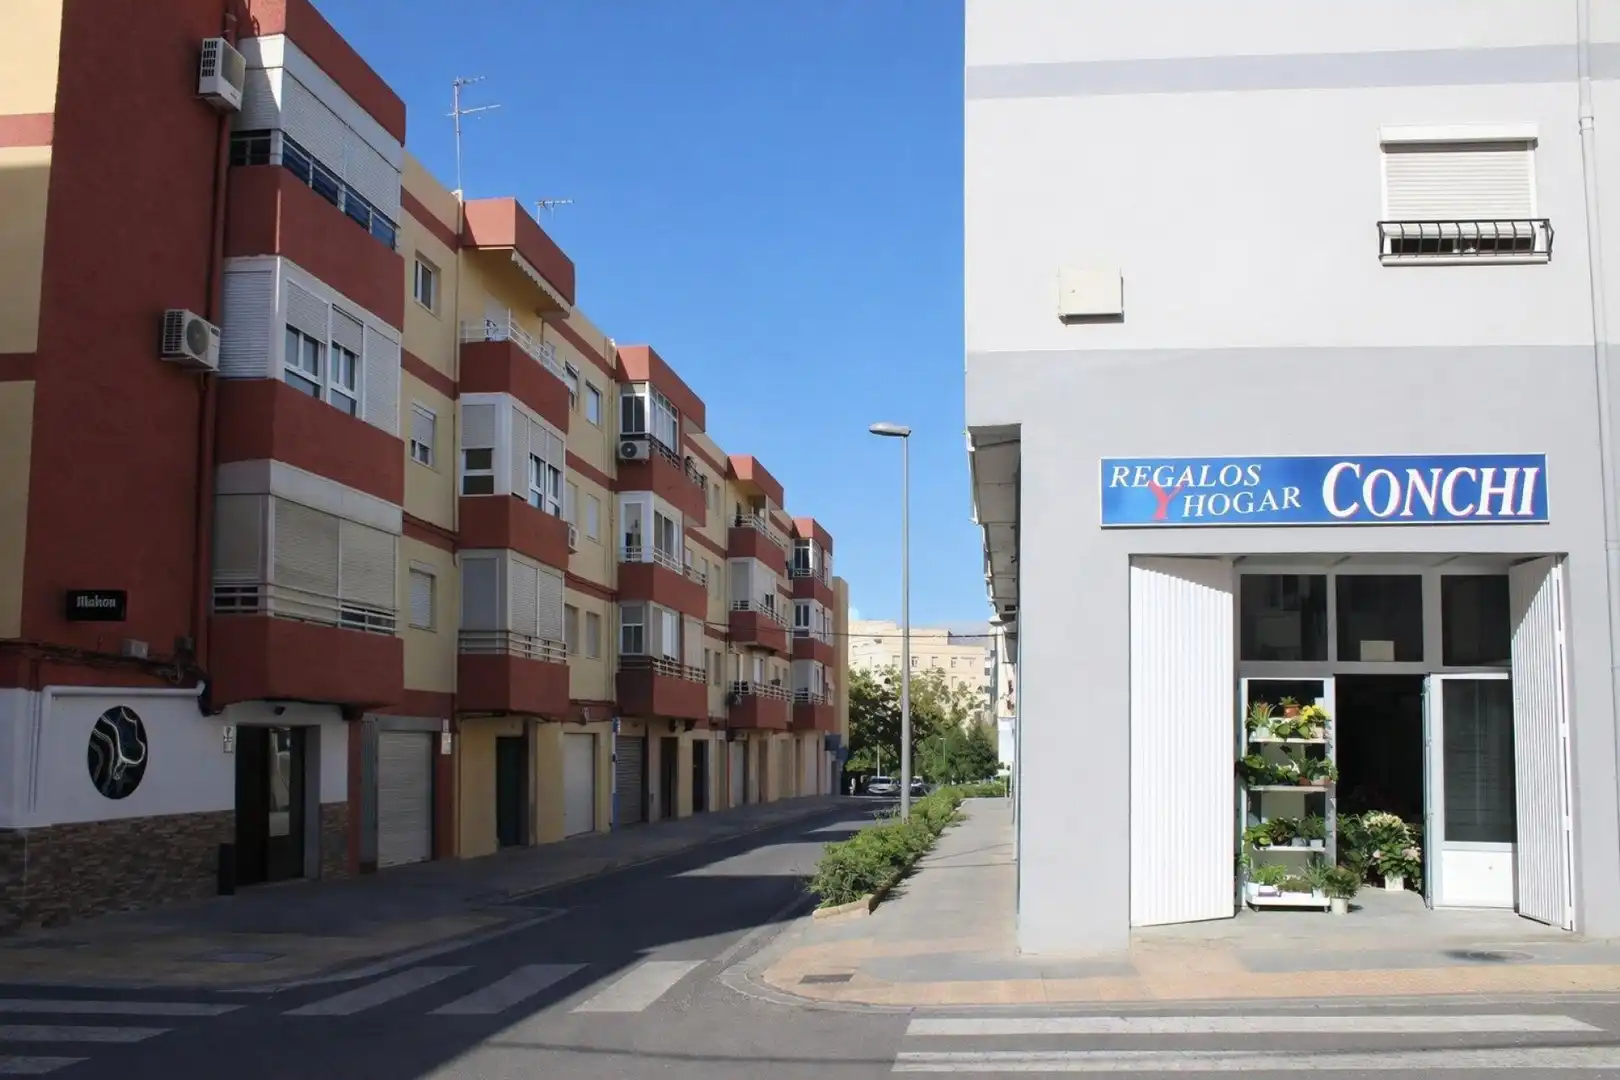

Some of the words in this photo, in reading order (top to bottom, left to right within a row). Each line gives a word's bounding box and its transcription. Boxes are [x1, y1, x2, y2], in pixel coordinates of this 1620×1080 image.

[1109, 464, 1262, 488] REGALOS
[1322, 462, 1540, 518] CONCHI
[1149, 480, 1186, 520] Y
[1181, 486, 1302, 518] HOGAR
